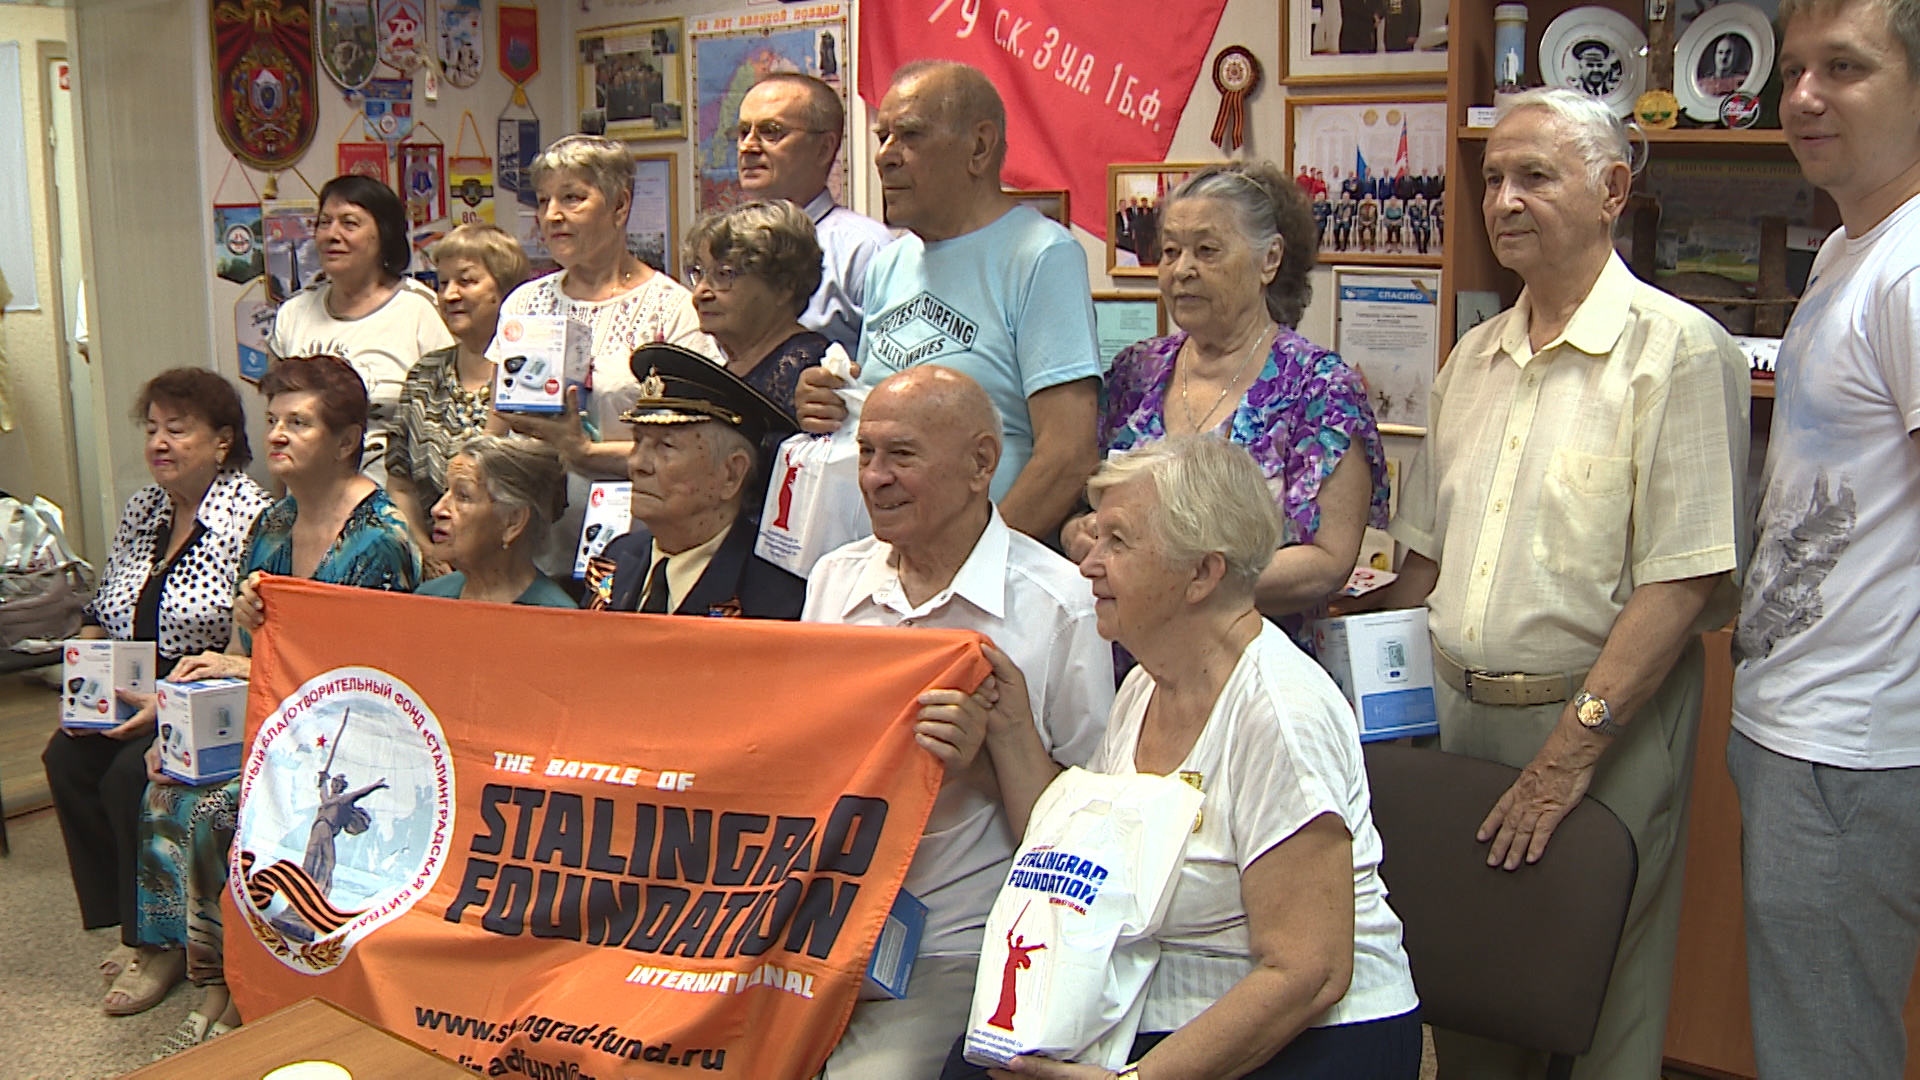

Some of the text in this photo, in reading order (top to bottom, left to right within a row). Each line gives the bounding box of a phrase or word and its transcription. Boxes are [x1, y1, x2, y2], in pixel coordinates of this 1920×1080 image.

[739, 9, 787, 28] ВЕЛИКОЙ
[793, 4, 840, 20] ПОБЕДЫ
[1033, 26, 1060, 71] 3
[1104, 63, 1124, 105] 1
[1378, 291, 1424, 301] СПАСИБО
[921, 297, 974, 344] SURFING
[878, 337, 946, 368] SALTY WAVES
[261, 677, 393, 748] БЛАГОТВОРИТЕЛЬНЫЙ
[394, 692, 426, 730] ФОНД
[493, 751, 696, 792] THE BATTLE OF
